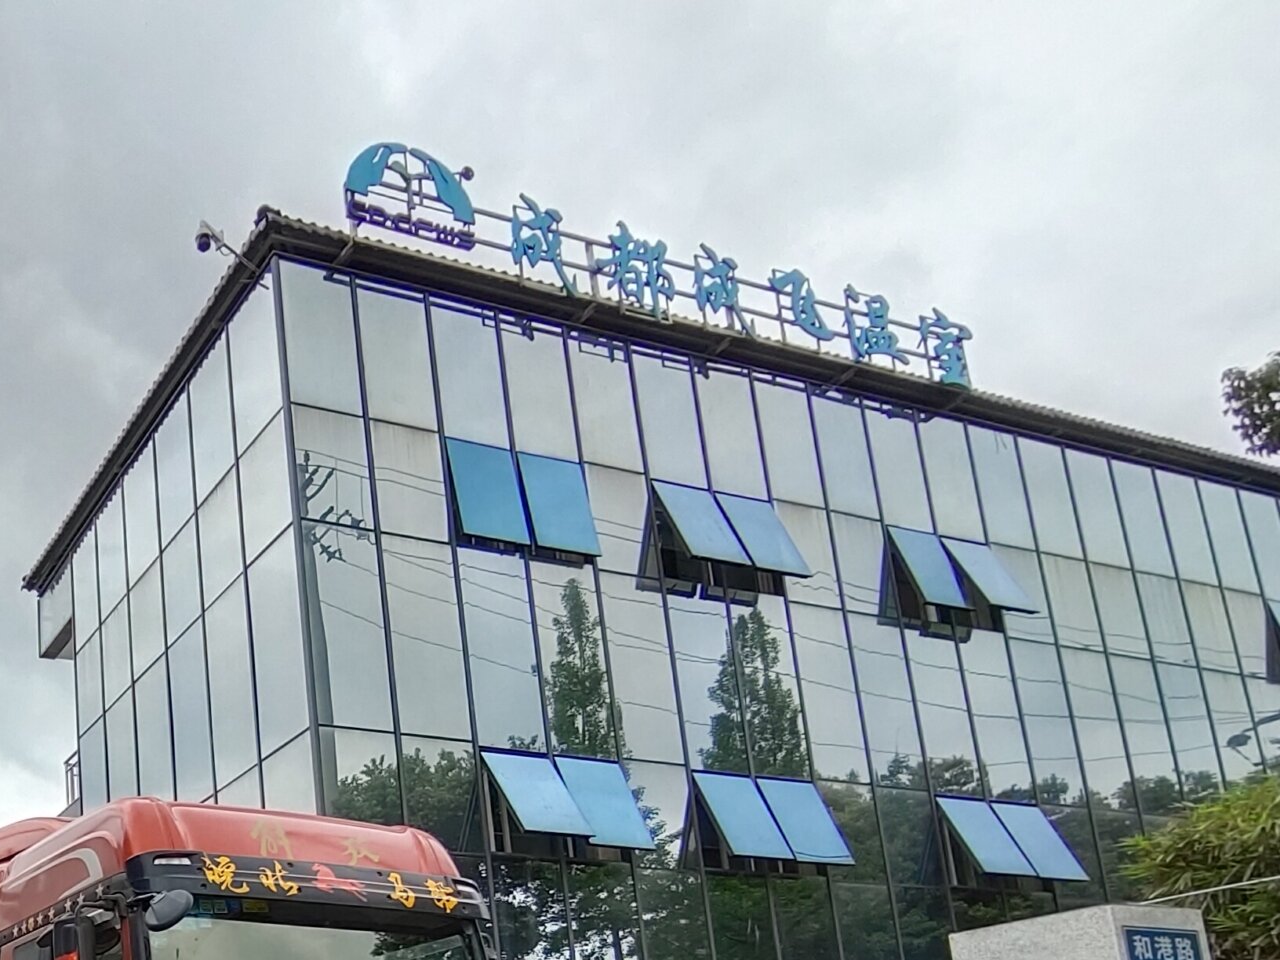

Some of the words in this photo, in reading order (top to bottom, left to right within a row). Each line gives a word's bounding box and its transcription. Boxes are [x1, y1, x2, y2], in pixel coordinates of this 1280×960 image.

[510, 193, 973, 390] 成都成飞温室
